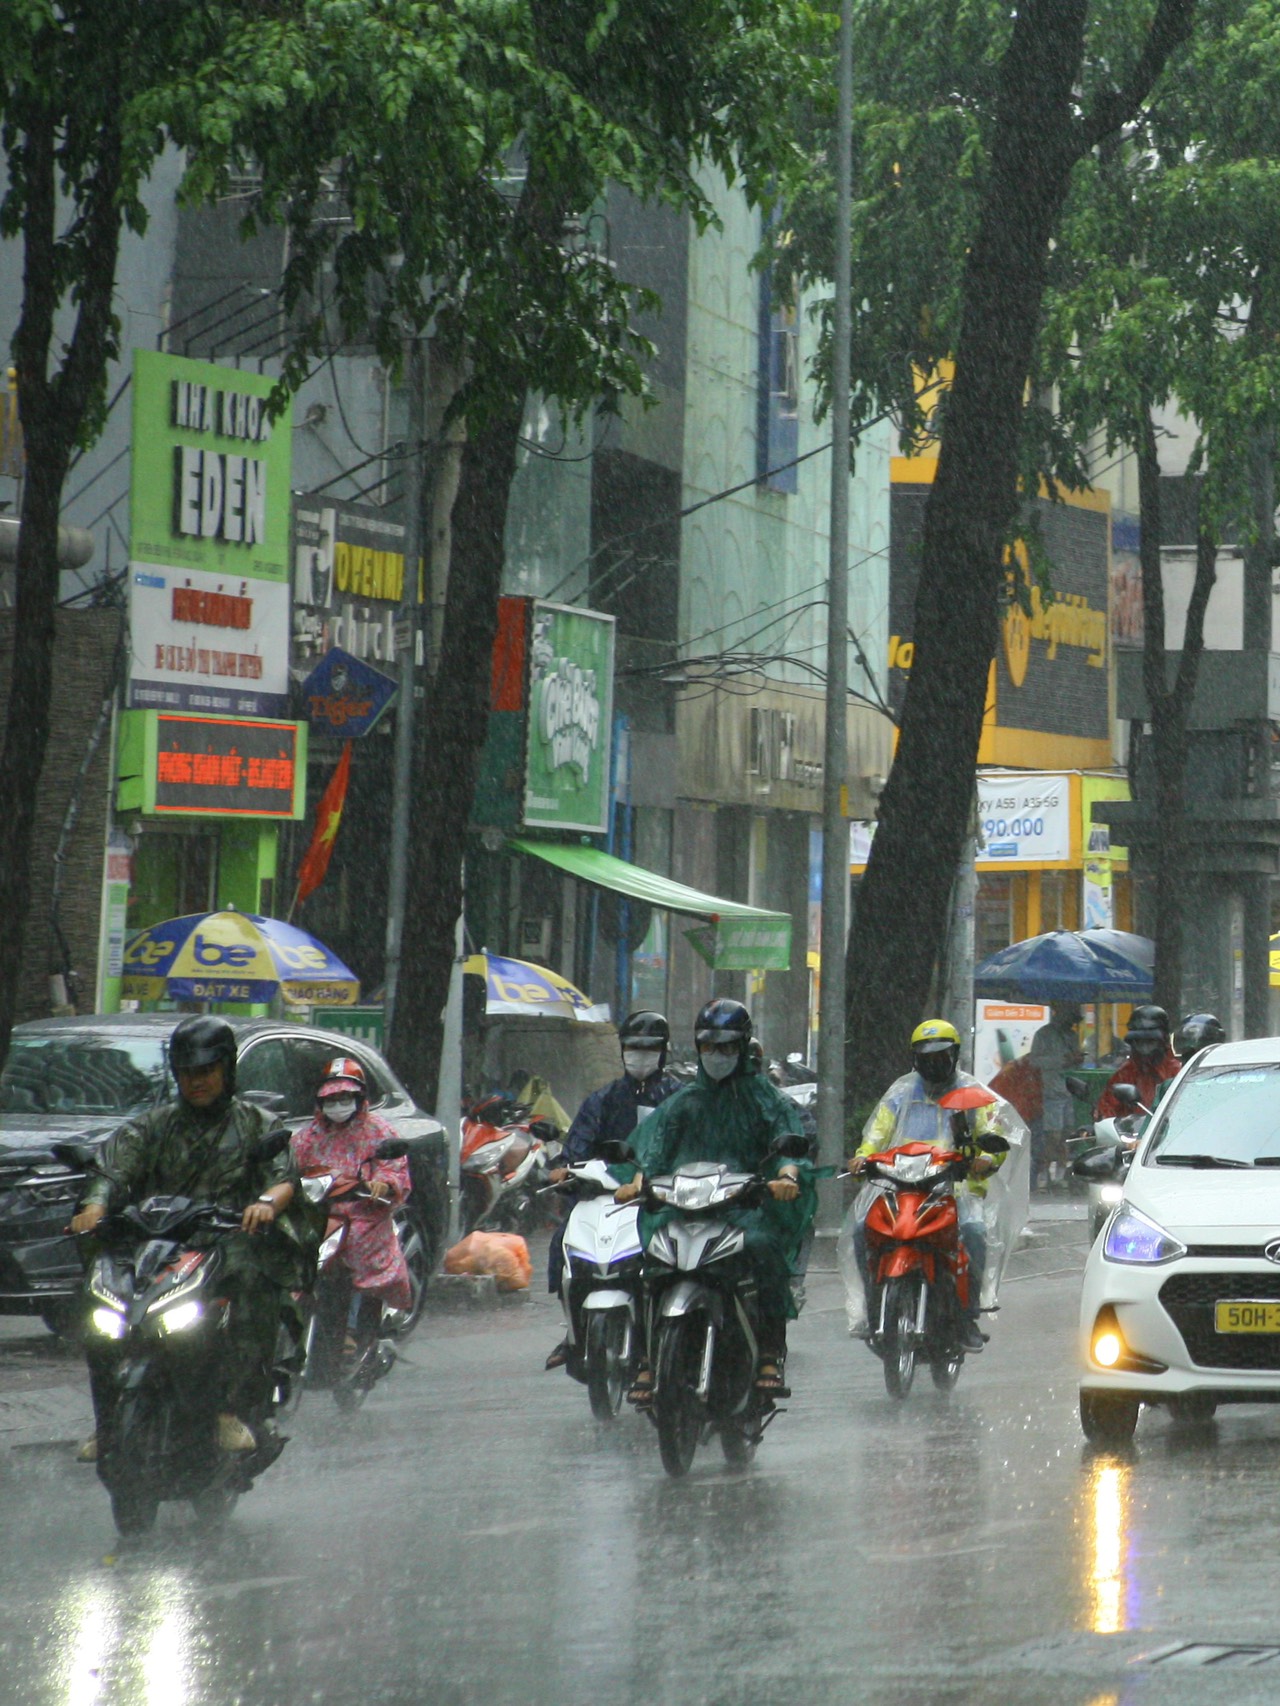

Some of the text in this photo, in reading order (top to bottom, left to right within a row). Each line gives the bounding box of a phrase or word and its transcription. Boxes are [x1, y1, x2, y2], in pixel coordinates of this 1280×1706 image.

[171, 380, 214, 432] NHA
[174, 445, 266, 544] EDEN
[308, 694, 375, 726] Tiger
[981, 817, 1044, 838] 90.000
[124, 932, 175, 965] be
[193, 934, 257, 967] be
[269, 937, 328, 970] be
[229, 984, 250, 998] XE
[490, 973, 551, 1004] be
[1019, 1007, 1025, 1017] 3
